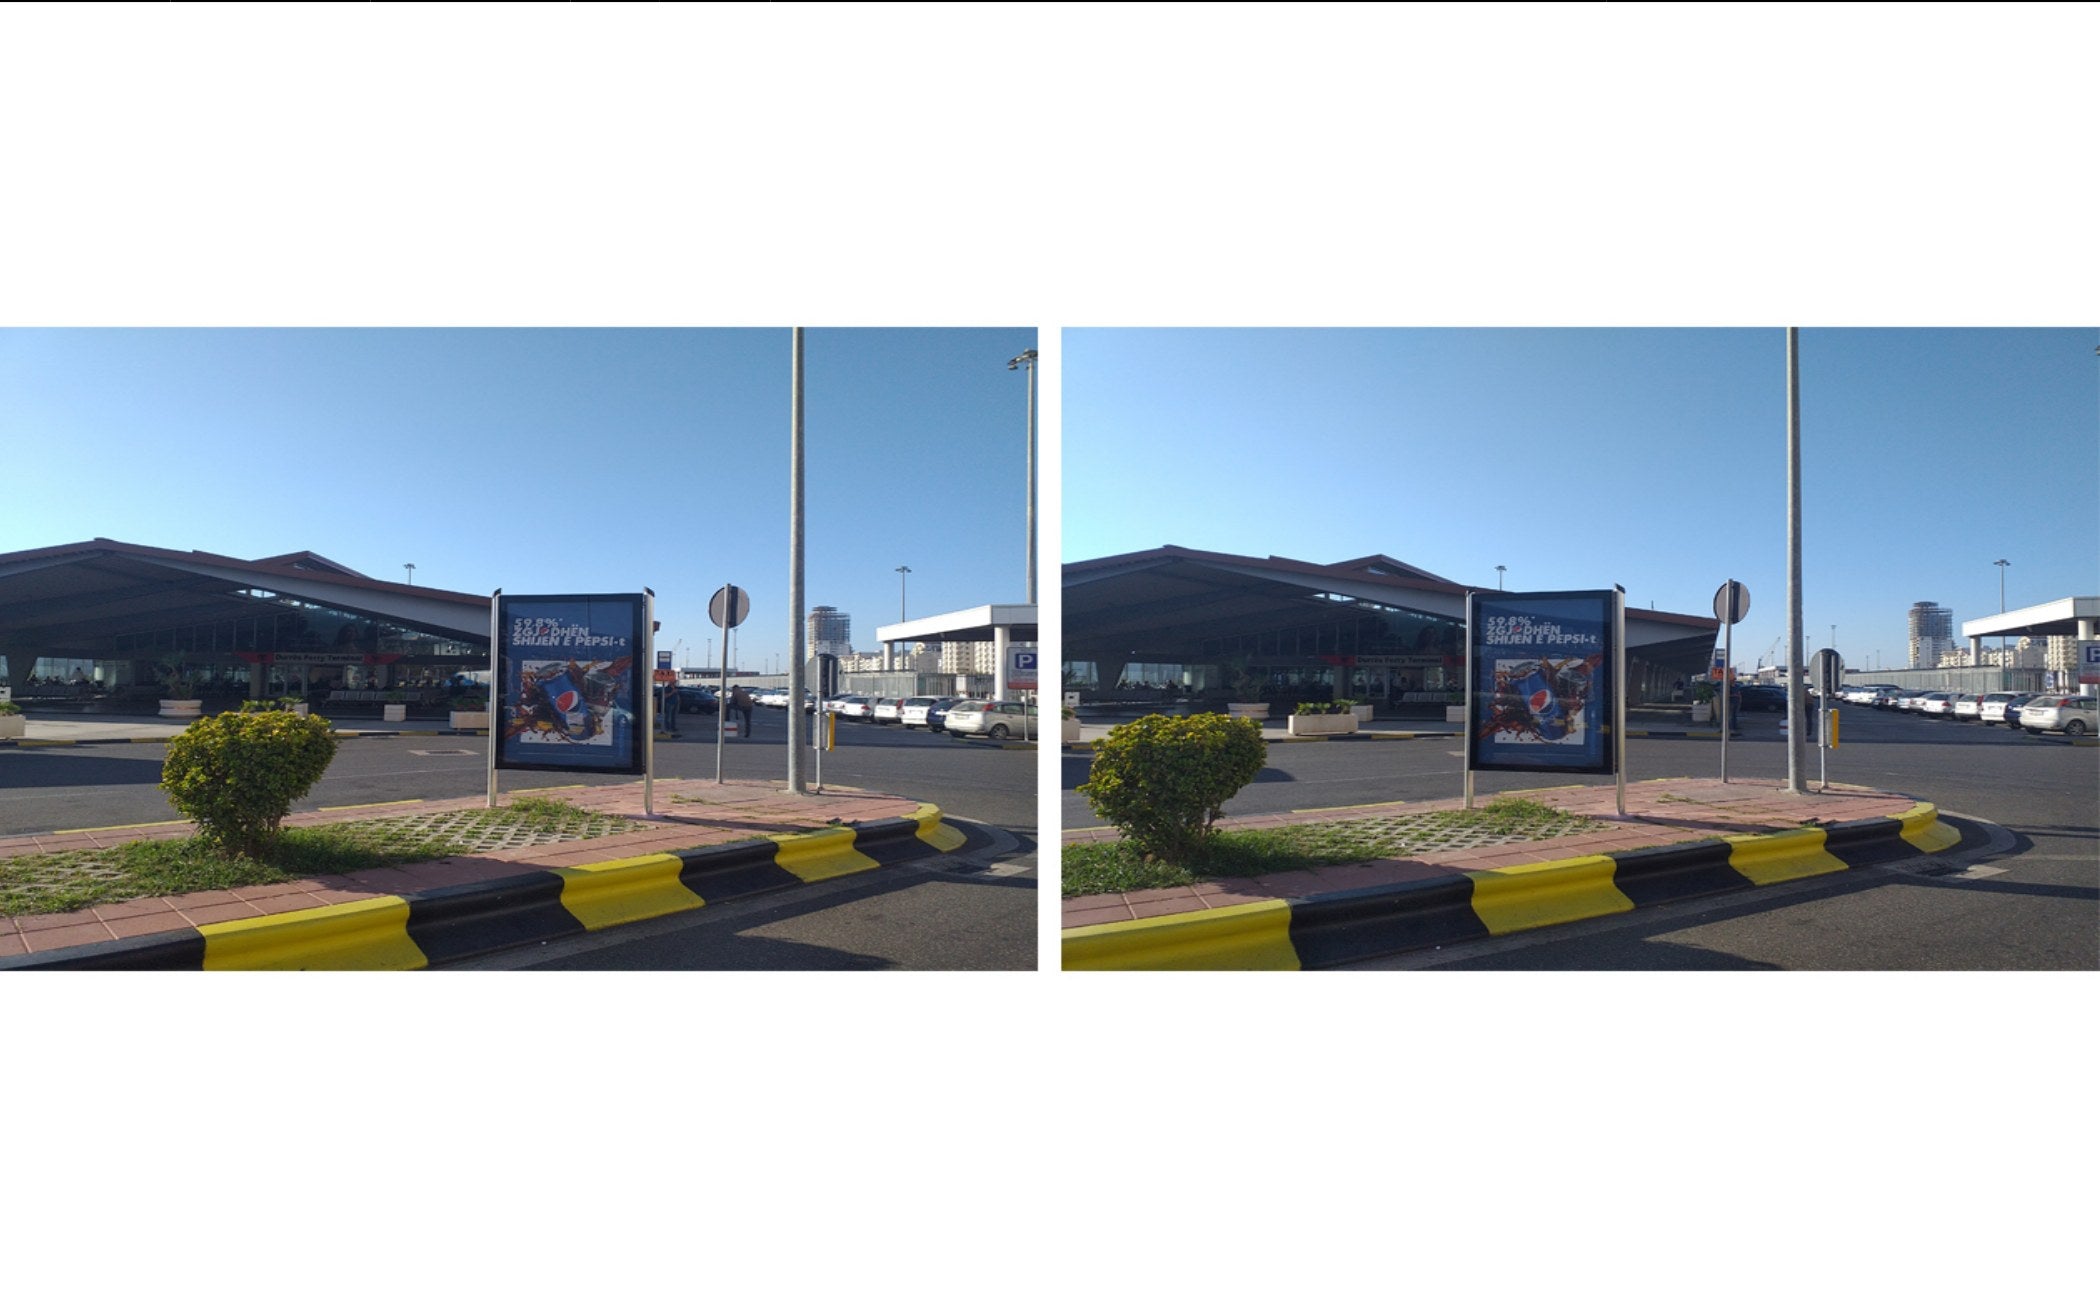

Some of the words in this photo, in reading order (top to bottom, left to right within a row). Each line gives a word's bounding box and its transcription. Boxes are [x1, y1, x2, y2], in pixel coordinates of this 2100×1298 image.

[512, 636, 559, 647] SHIJEN
[562, 636, 570, 646] E
[1486, 635, 1533, 645] SHIJEN
[1536, 635, 1543, 645] E
[303, 653, 326, 663] Ferry
[1019, 654, 1033, 668] P
